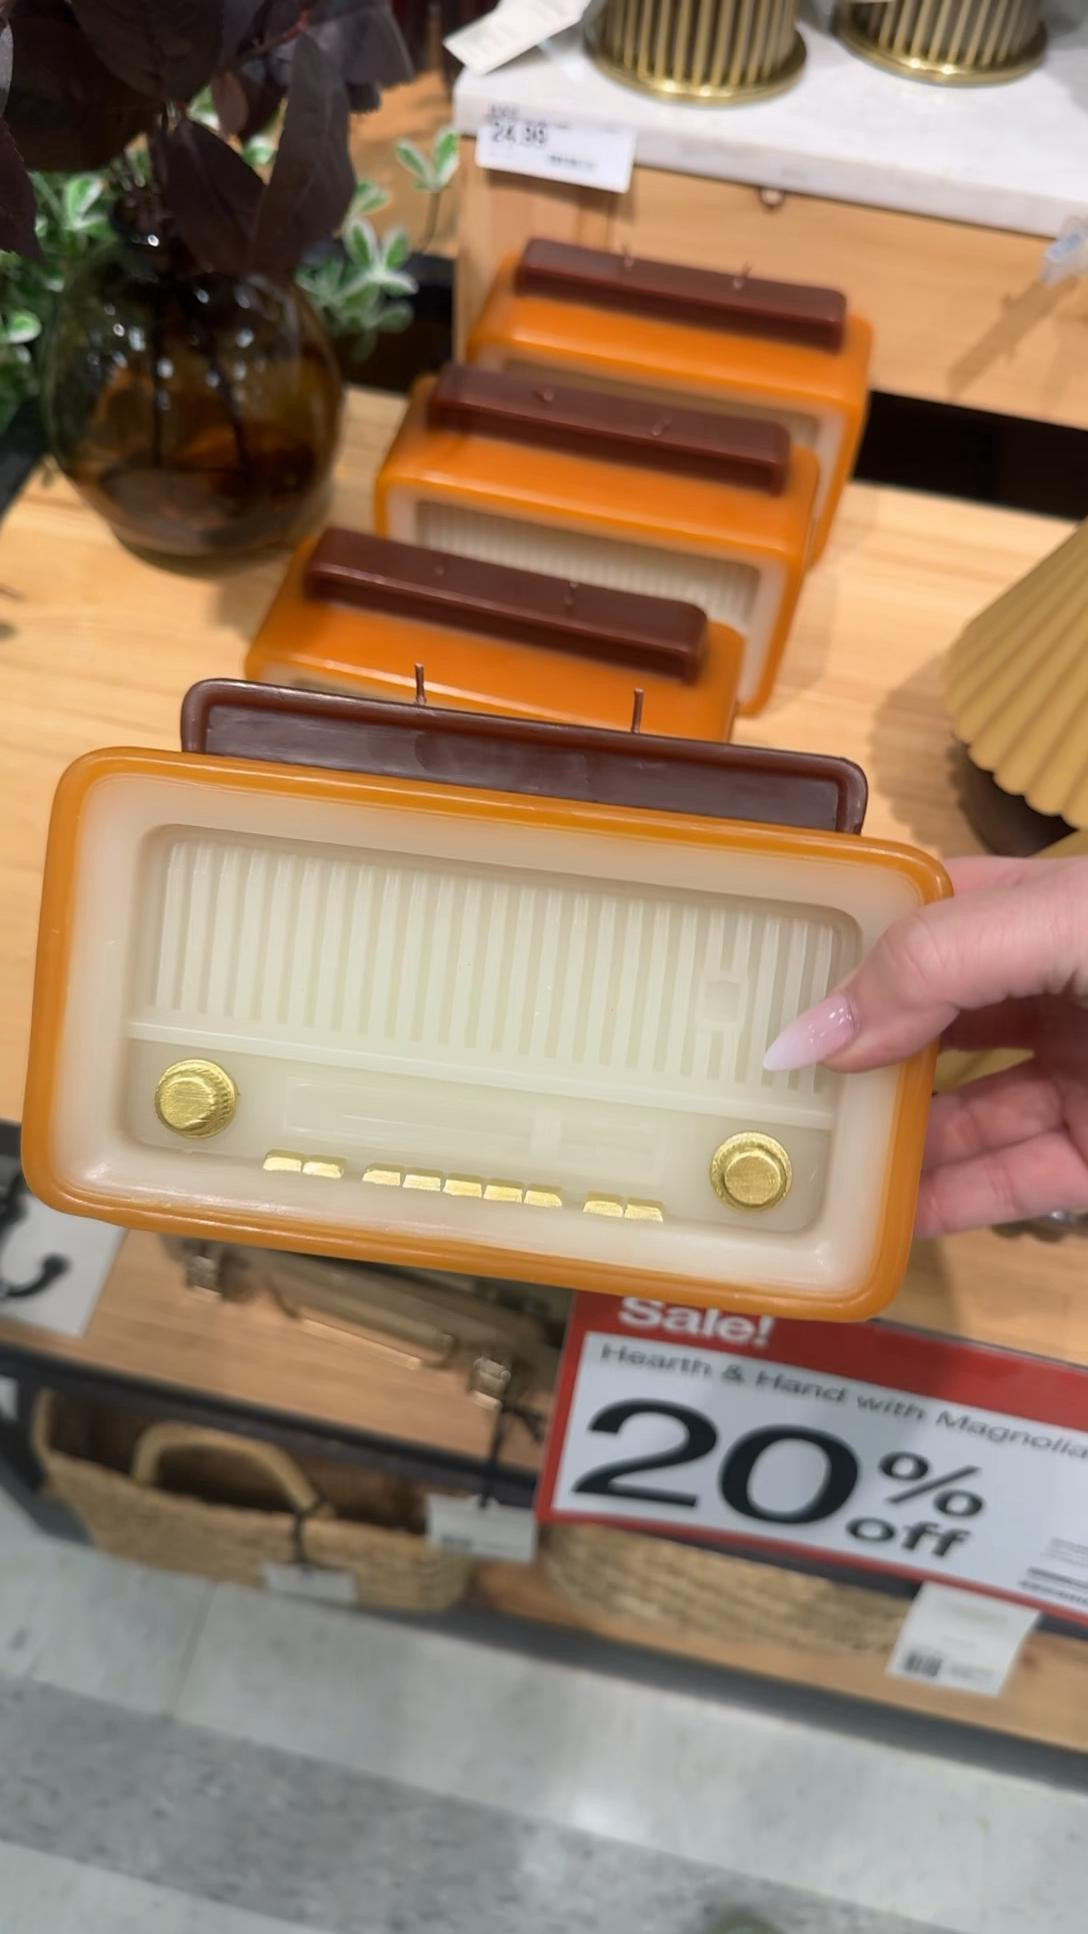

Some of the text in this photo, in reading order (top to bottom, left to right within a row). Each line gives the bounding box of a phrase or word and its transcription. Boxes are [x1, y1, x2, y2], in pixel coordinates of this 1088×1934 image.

[618, 1296, 775, 1348] Sale!
[601, 1343, 1088, 1459] Hearth & Hand with Magnolia
[846, 1518, 972, 1559] off
